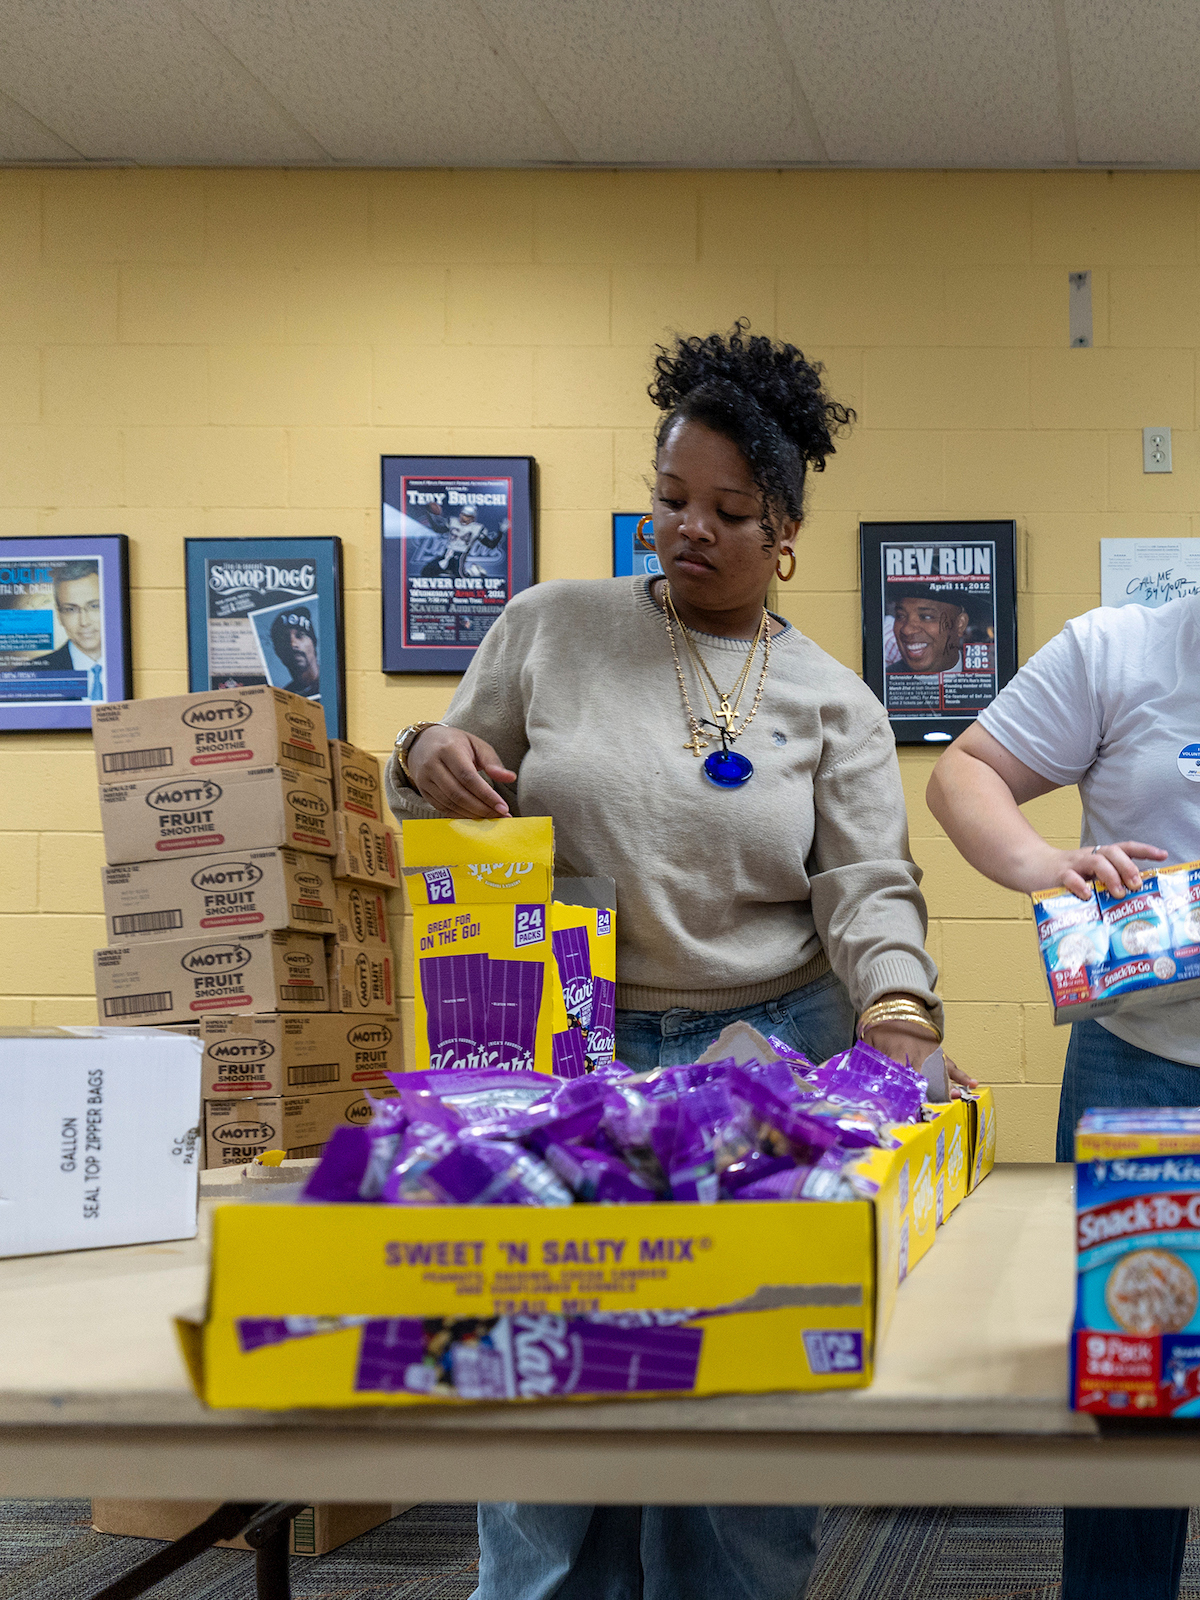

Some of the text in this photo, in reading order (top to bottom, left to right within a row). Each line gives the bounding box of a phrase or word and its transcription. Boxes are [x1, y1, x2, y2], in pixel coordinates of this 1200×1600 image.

[406, 490, 506, 505] TEDY BRUSCHI
[886, 548, 990, 575] REV RUN
[454, 578, 483, 589] GIVE
[1157, 568, 1174, 587] ME
[930, 582, 952, 591] April
[955, 583, 968, 591] 11,
[190, 702, 248, 723] MOTT'S
[195, 729, 245, 744] FRUIT
[196, 741, 246, 753] SMOOTHIE
[155, 783, 215, 805] MOTT'S
[159, 810, 214, 828] FRUIT
[294, 813, 325, 828] FRUIT
[160, 824, 215, 836] SMOOTHIE
[199, 863, 258, 885] MOTT'S
[427, 870, 448, 881] PACKS
[430, 880, 452, 901] 24
[204, 891, 255, 907] FRUIT
[206, 904, 256, 916] SMOOTHIE
[427, 913, 471, 934] GREAT FOR
[517, 908, 542, 931] 24
[598, 913, 610, 926] 24
[420, 922, 480, 951] ON THE GO!
[520, 930, 541, 941] PACKS
[189, 945, 247, 967] MOTT'S
[194, 973, 244, 989] FRUIT
[359, 959, 368, 1001] MOTT'S
[1055, 973, 1063, 981] 9
[195, 986, 245, 998] SMOOTHIE
[352, 1026, 388, 1042] MOTT'S
[215, 1041, 269, 1056] MOTT'S
[355, 1051, 388, 1063] FRUIT
[218, 1064, 266, 1075] FRUIT
[218, 1074, 266, 1082] SMOOTHIE
[220, 1123, 271, 1139] MOTT'S
[60, 1118, 78, 1172] GALLON
[83, 1069, 104, 1219] SEAL TOP ZIPPER BAGS
[385, 1240, 485, 1266] SWEET
[498, 1240, 529, 1266] 'N
[542, 1238, 626, 1265] SALTY
[1087, 1336, 1106, 1358] 9
